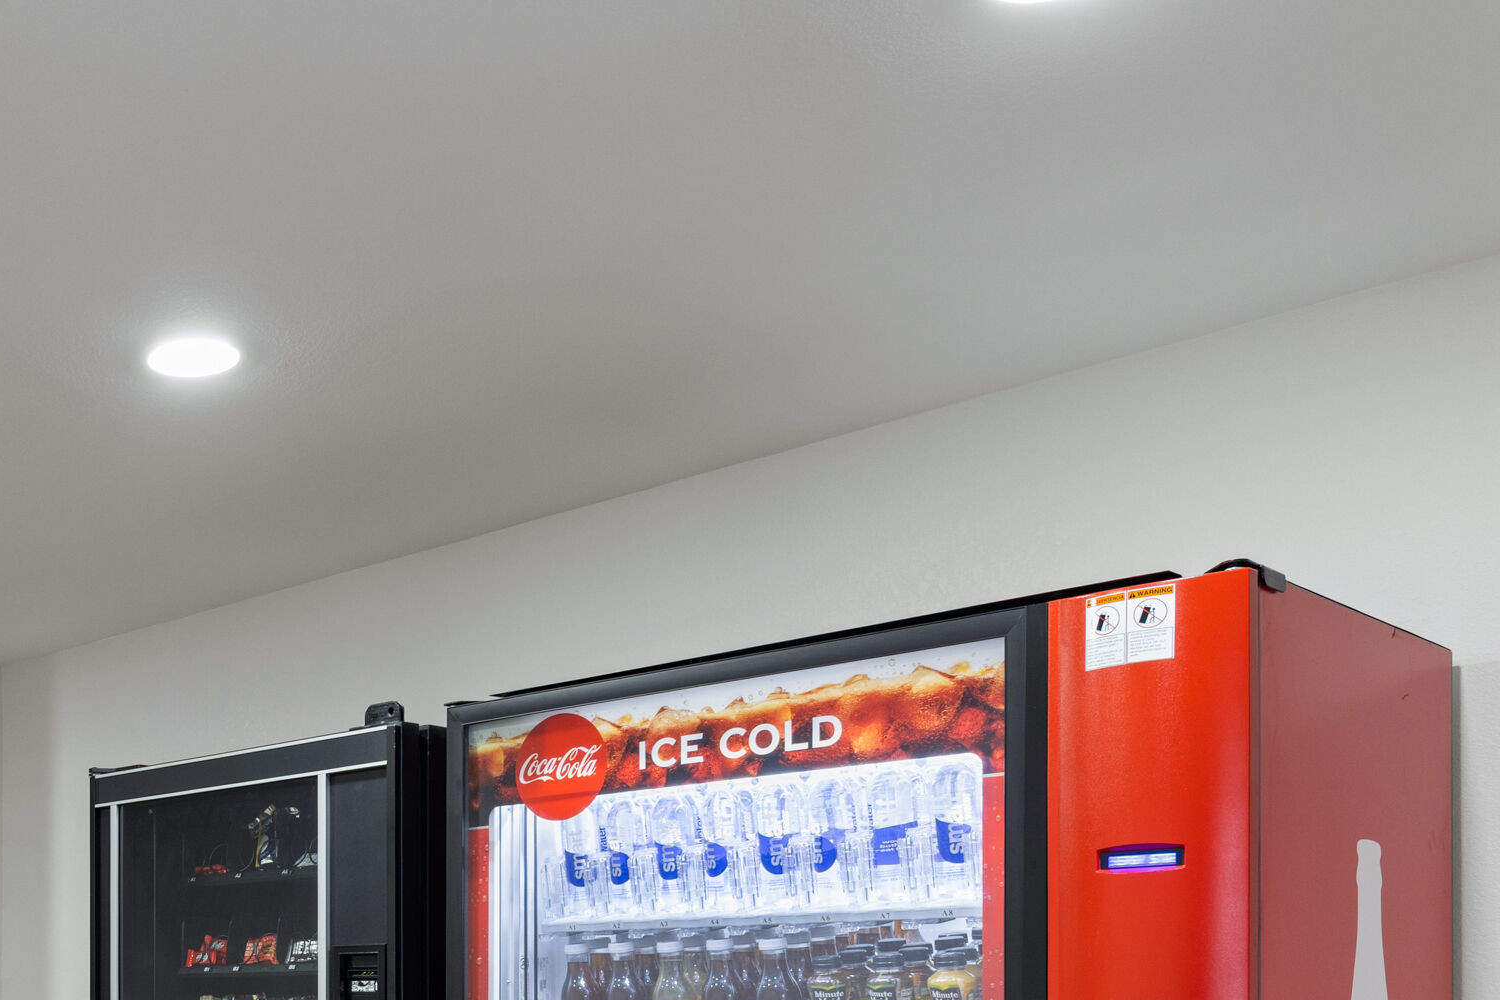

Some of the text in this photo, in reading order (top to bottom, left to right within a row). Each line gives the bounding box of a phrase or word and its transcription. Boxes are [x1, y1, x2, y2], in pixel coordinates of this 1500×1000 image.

[1137, 586, 1173, 597] WARNING
[638, 715, 843, 770] ICE COLD
[519, 743, 602, 785] Coca-Cola
[814, 990, 845, 998] Minute
[931, 990, 959, 998] Minute
